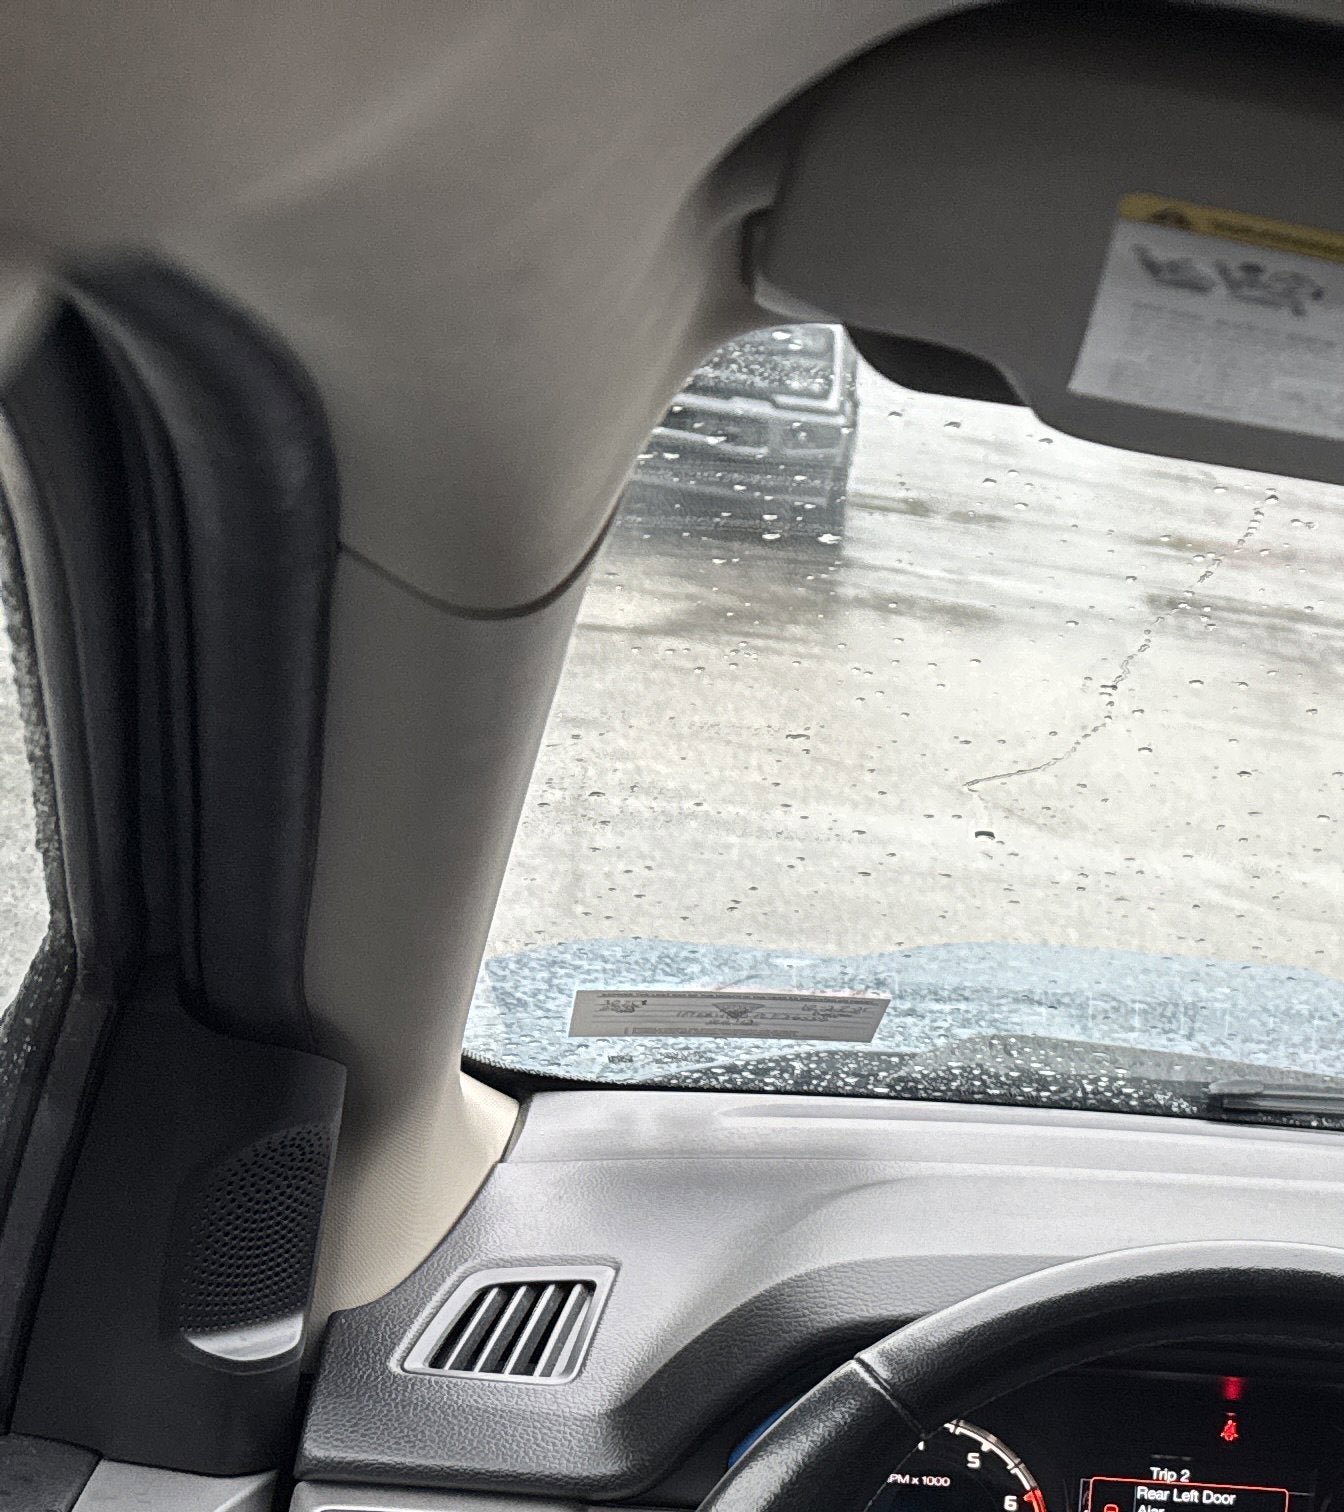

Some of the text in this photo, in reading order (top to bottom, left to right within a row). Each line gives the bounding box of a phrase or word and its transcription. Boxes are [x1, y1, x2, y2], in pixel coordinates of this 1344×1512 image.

[966, 1452, 981, 1469] 5
[887, 1473, 910, 1485] PM
[921, 1475, 951, 1487] 1000
[1150, 1466, 1191, 1483] Trip 2
[1003, 1495, 1018, 1511] 6
[1136, 1486, 1237, 1505] Rear Left Door
